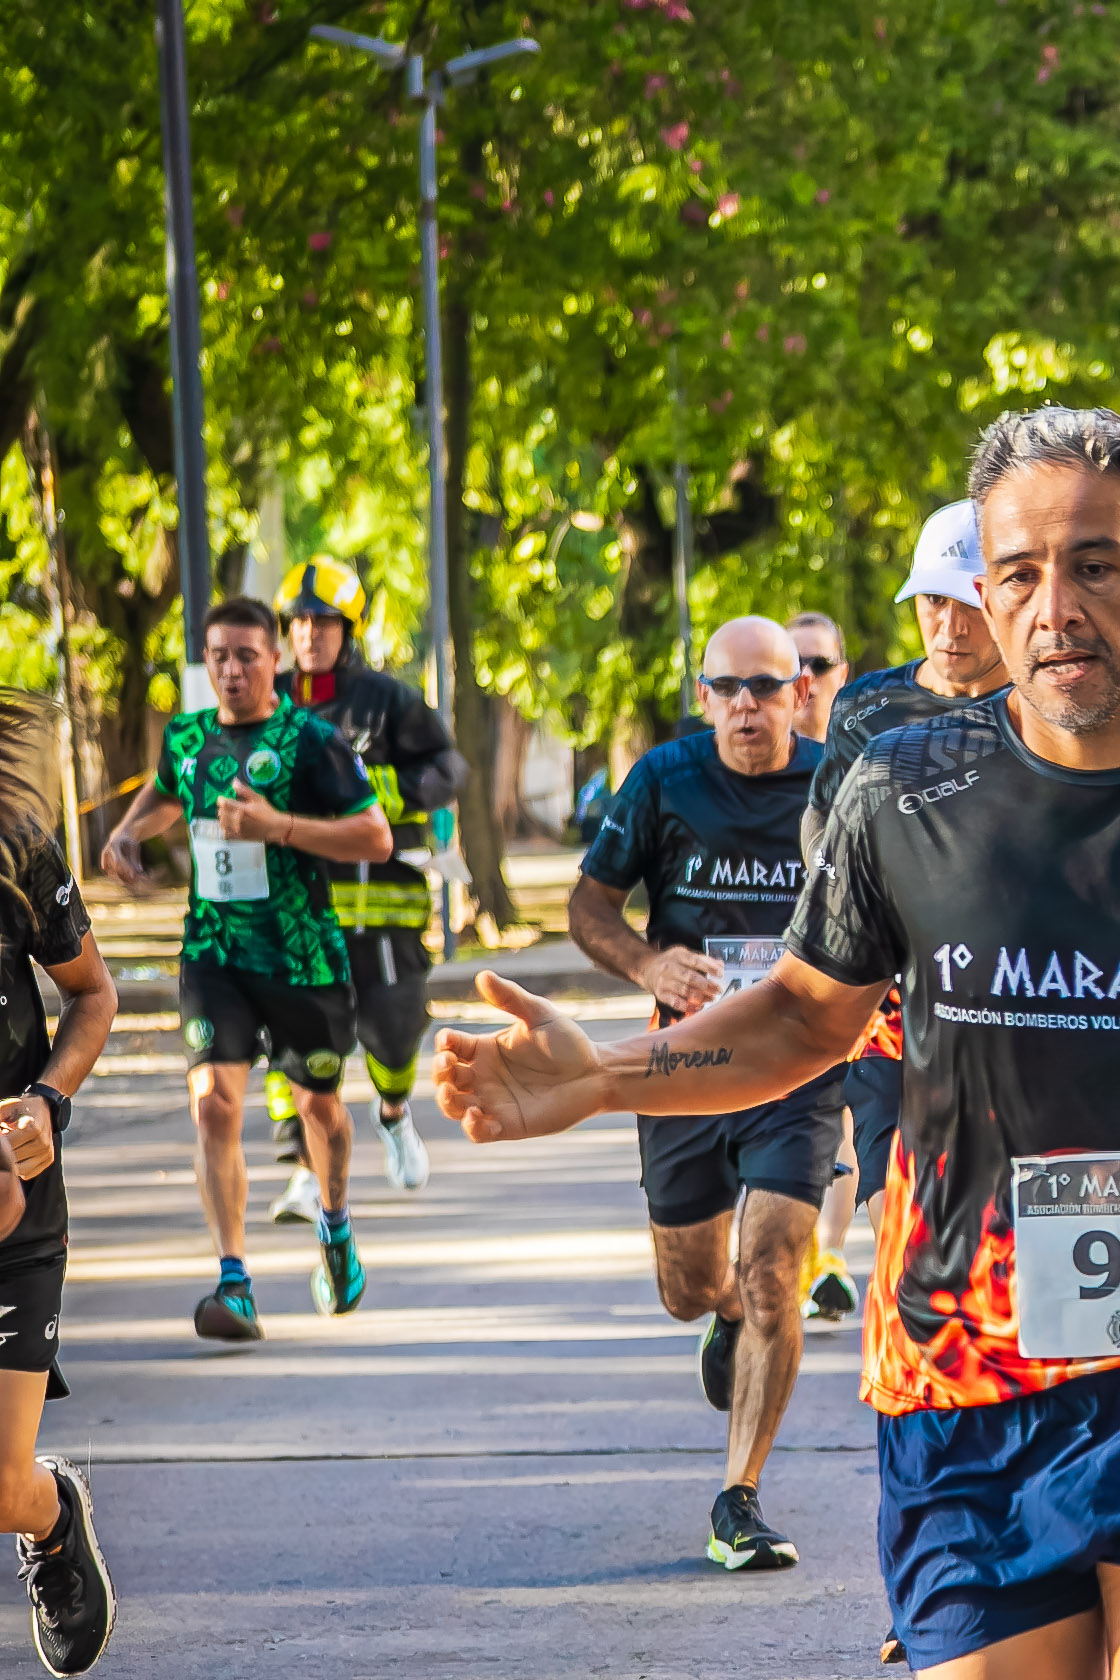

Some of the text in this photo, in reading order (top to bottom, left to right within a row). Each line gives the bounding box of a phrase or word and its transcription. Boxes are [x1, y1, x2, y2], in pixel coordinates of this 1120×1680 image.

[215, 850, 233, 876] 8
[709, 855, 809, 888] MARAT
[738, 946, 785, 961] MARAT
[934, 1001, 1001, 1025] ASOCIACIÓN
[1004, 1011, 1088, 1030] BOMBEROS
